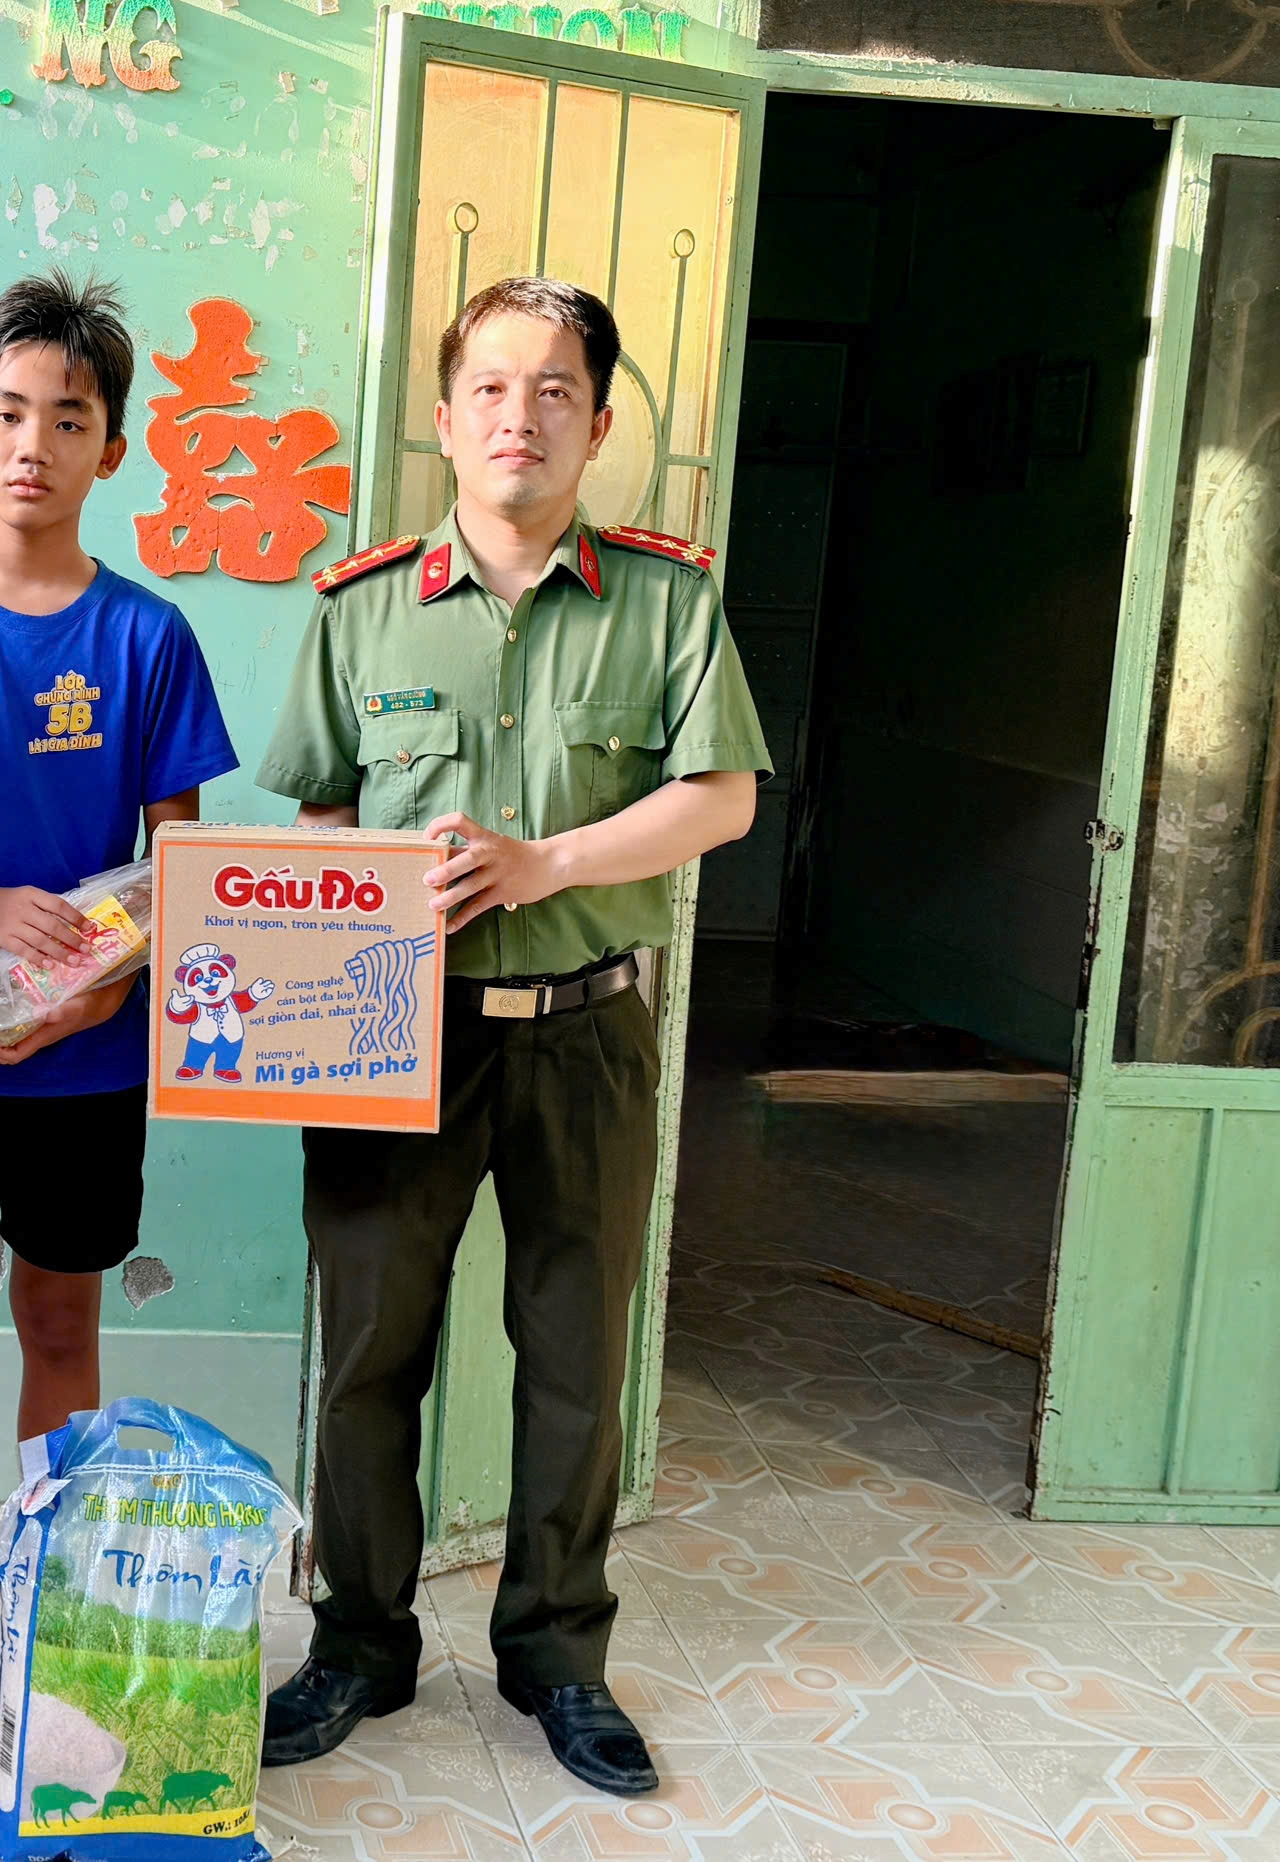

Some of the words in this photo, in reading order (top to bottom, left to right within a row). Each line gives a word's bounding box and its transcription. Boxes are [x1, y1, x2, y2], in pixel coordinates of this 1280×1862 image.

[45, 702, 92, 735] 5B
[214, 866, 313, 908] Gấu
[319, 869, 384, 912] Đỏ
[205, 915, 234, 927] Khơi
[238, 917, 248, 928] vị
[252, 919, 287, 931] ngon,
[292, 919, 318, 930] tròn
[322, 920, 344, 932] yêu
[285, 980, 314, 990] Công
[317, 976, 344, 988] nghệ
[298, 993, 317, 1005] bột
[320, 992, 334, 1001] đa
[249, 1015, 265, 1026] sợi
[268, 1011, 296, 1026] giòn
[300, 1008, 324, 1020] dai,
[328, 1004, 356, 1017] nhai
[256, 1050, 292, 1060] Hương
[295, 1048, 305, 1059] vị
[255, 1063, 284, 1083] Mì
[291, 1060, 320, 1085] gà
[327, 1057, 361, 1082] sợi
[369, 1053, 418, 1079] phở
